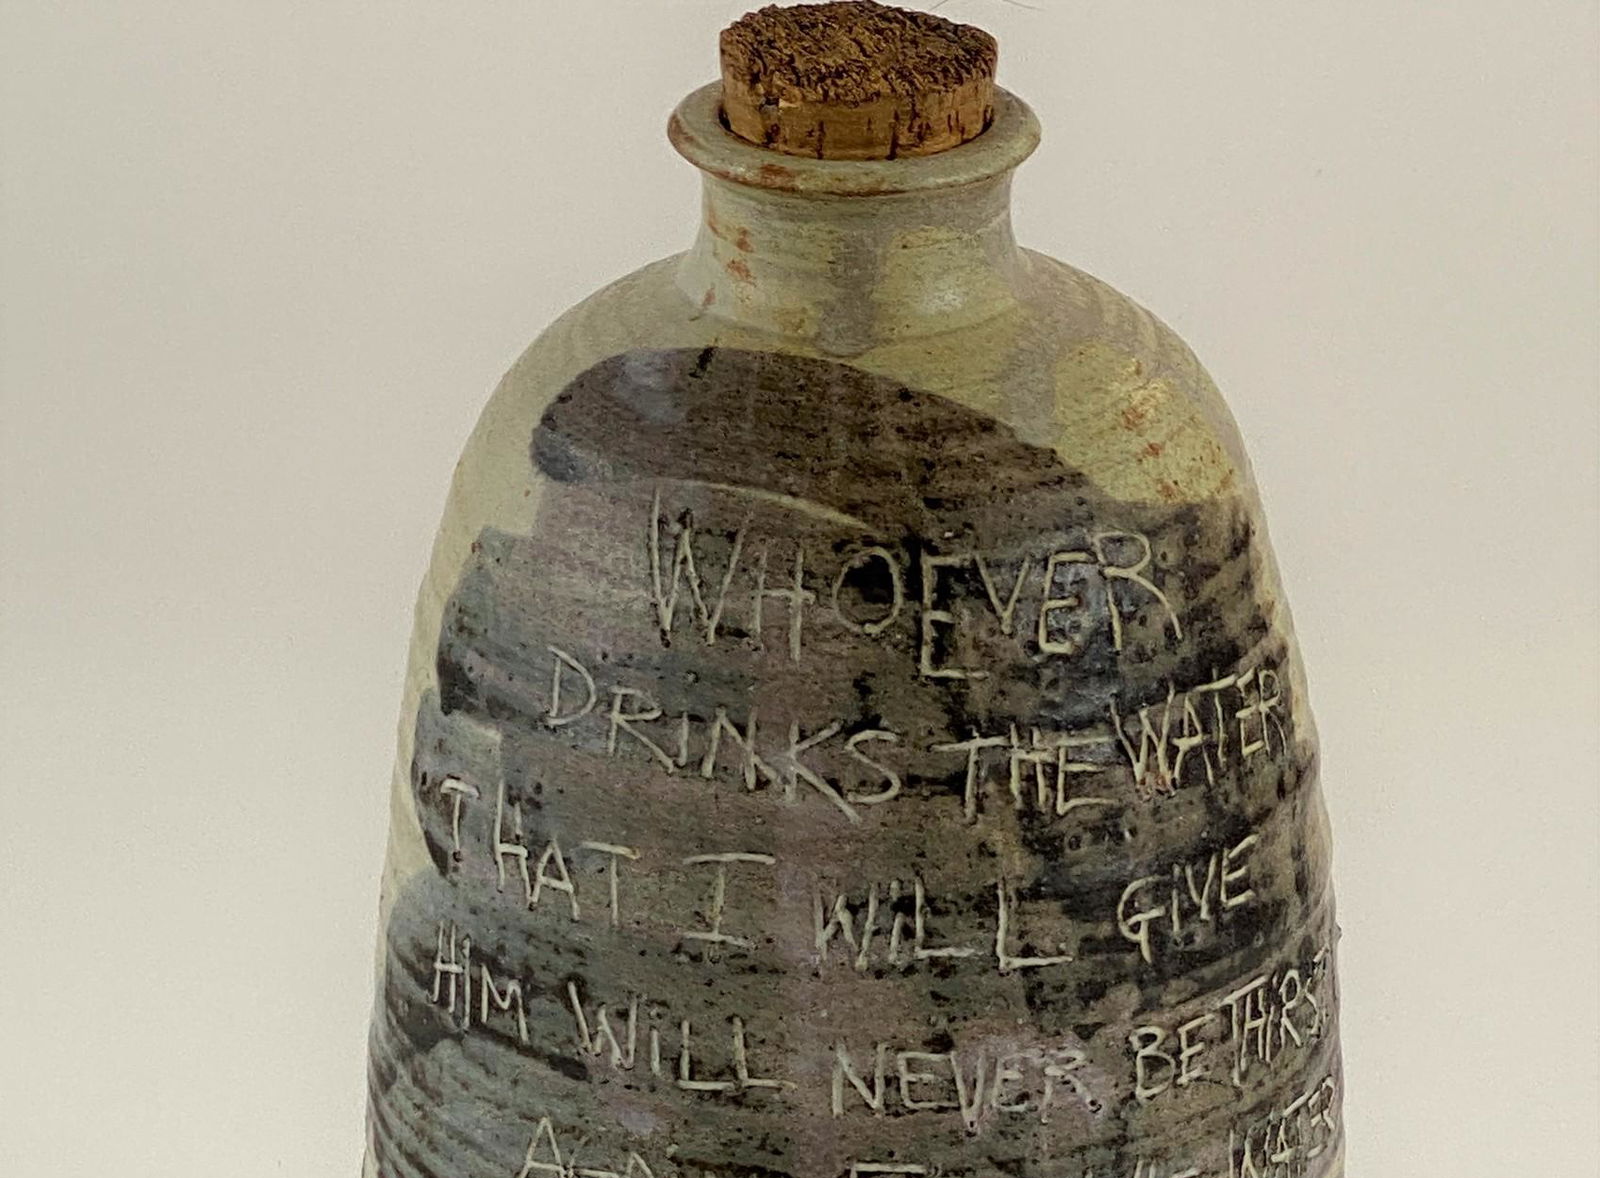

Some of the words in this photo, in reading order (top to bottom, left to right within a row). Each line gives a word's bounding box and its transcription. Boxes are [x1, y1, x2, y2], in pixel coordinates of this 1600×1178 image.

[648, 487, 1182, 679] WHOEVER
[544, 646, 900, 823] DRINKS
[931, 722, 1119, 824] THE
[1110, 668, 1287, 797] WATER
[440, 776, 640, 927] THAT
[682, 852, 776, 948] I
[814, 866, 1074, 970] WILL
[1117, 835, 1257, 964] GIVE
[432, 920, 530, 1046] HIM
[567, 980, 798, 1091] WILL
[832, 1042, 1102, 1133] NEVER
[1130, 1013, 1215, 1100] BE
